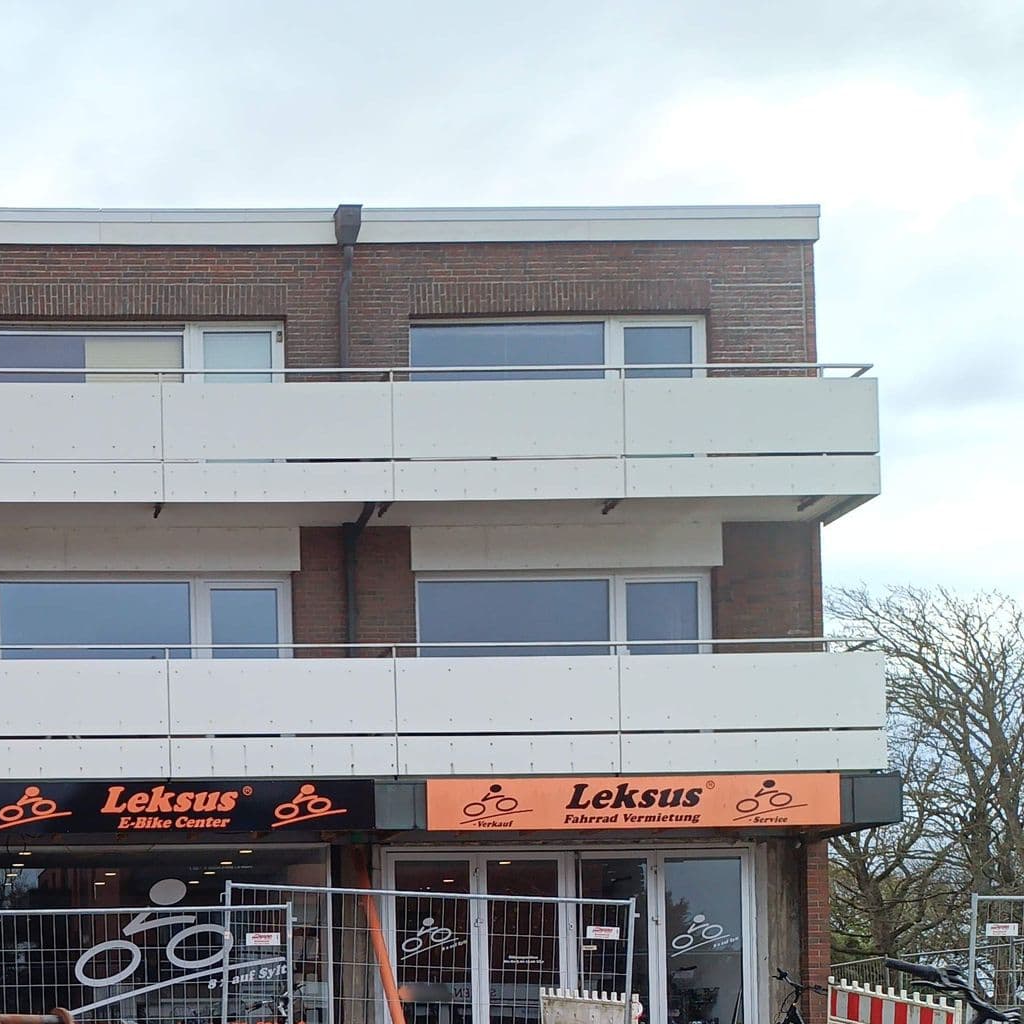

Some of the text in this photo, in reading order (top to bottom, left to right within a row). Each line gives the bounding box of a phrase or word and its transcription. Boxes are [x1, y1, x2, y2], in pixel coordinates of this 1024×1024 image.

[100, 785, 239, 814] Leksus
[565, 783, 703, 810] Leksus
[117, 816, 231, 829] E-Bike Center
[564, 812, 702, 824] Fahrrad Vermietung
[231, 969, 256, 985] auf
[258, 963, 288, 980] Sylt
